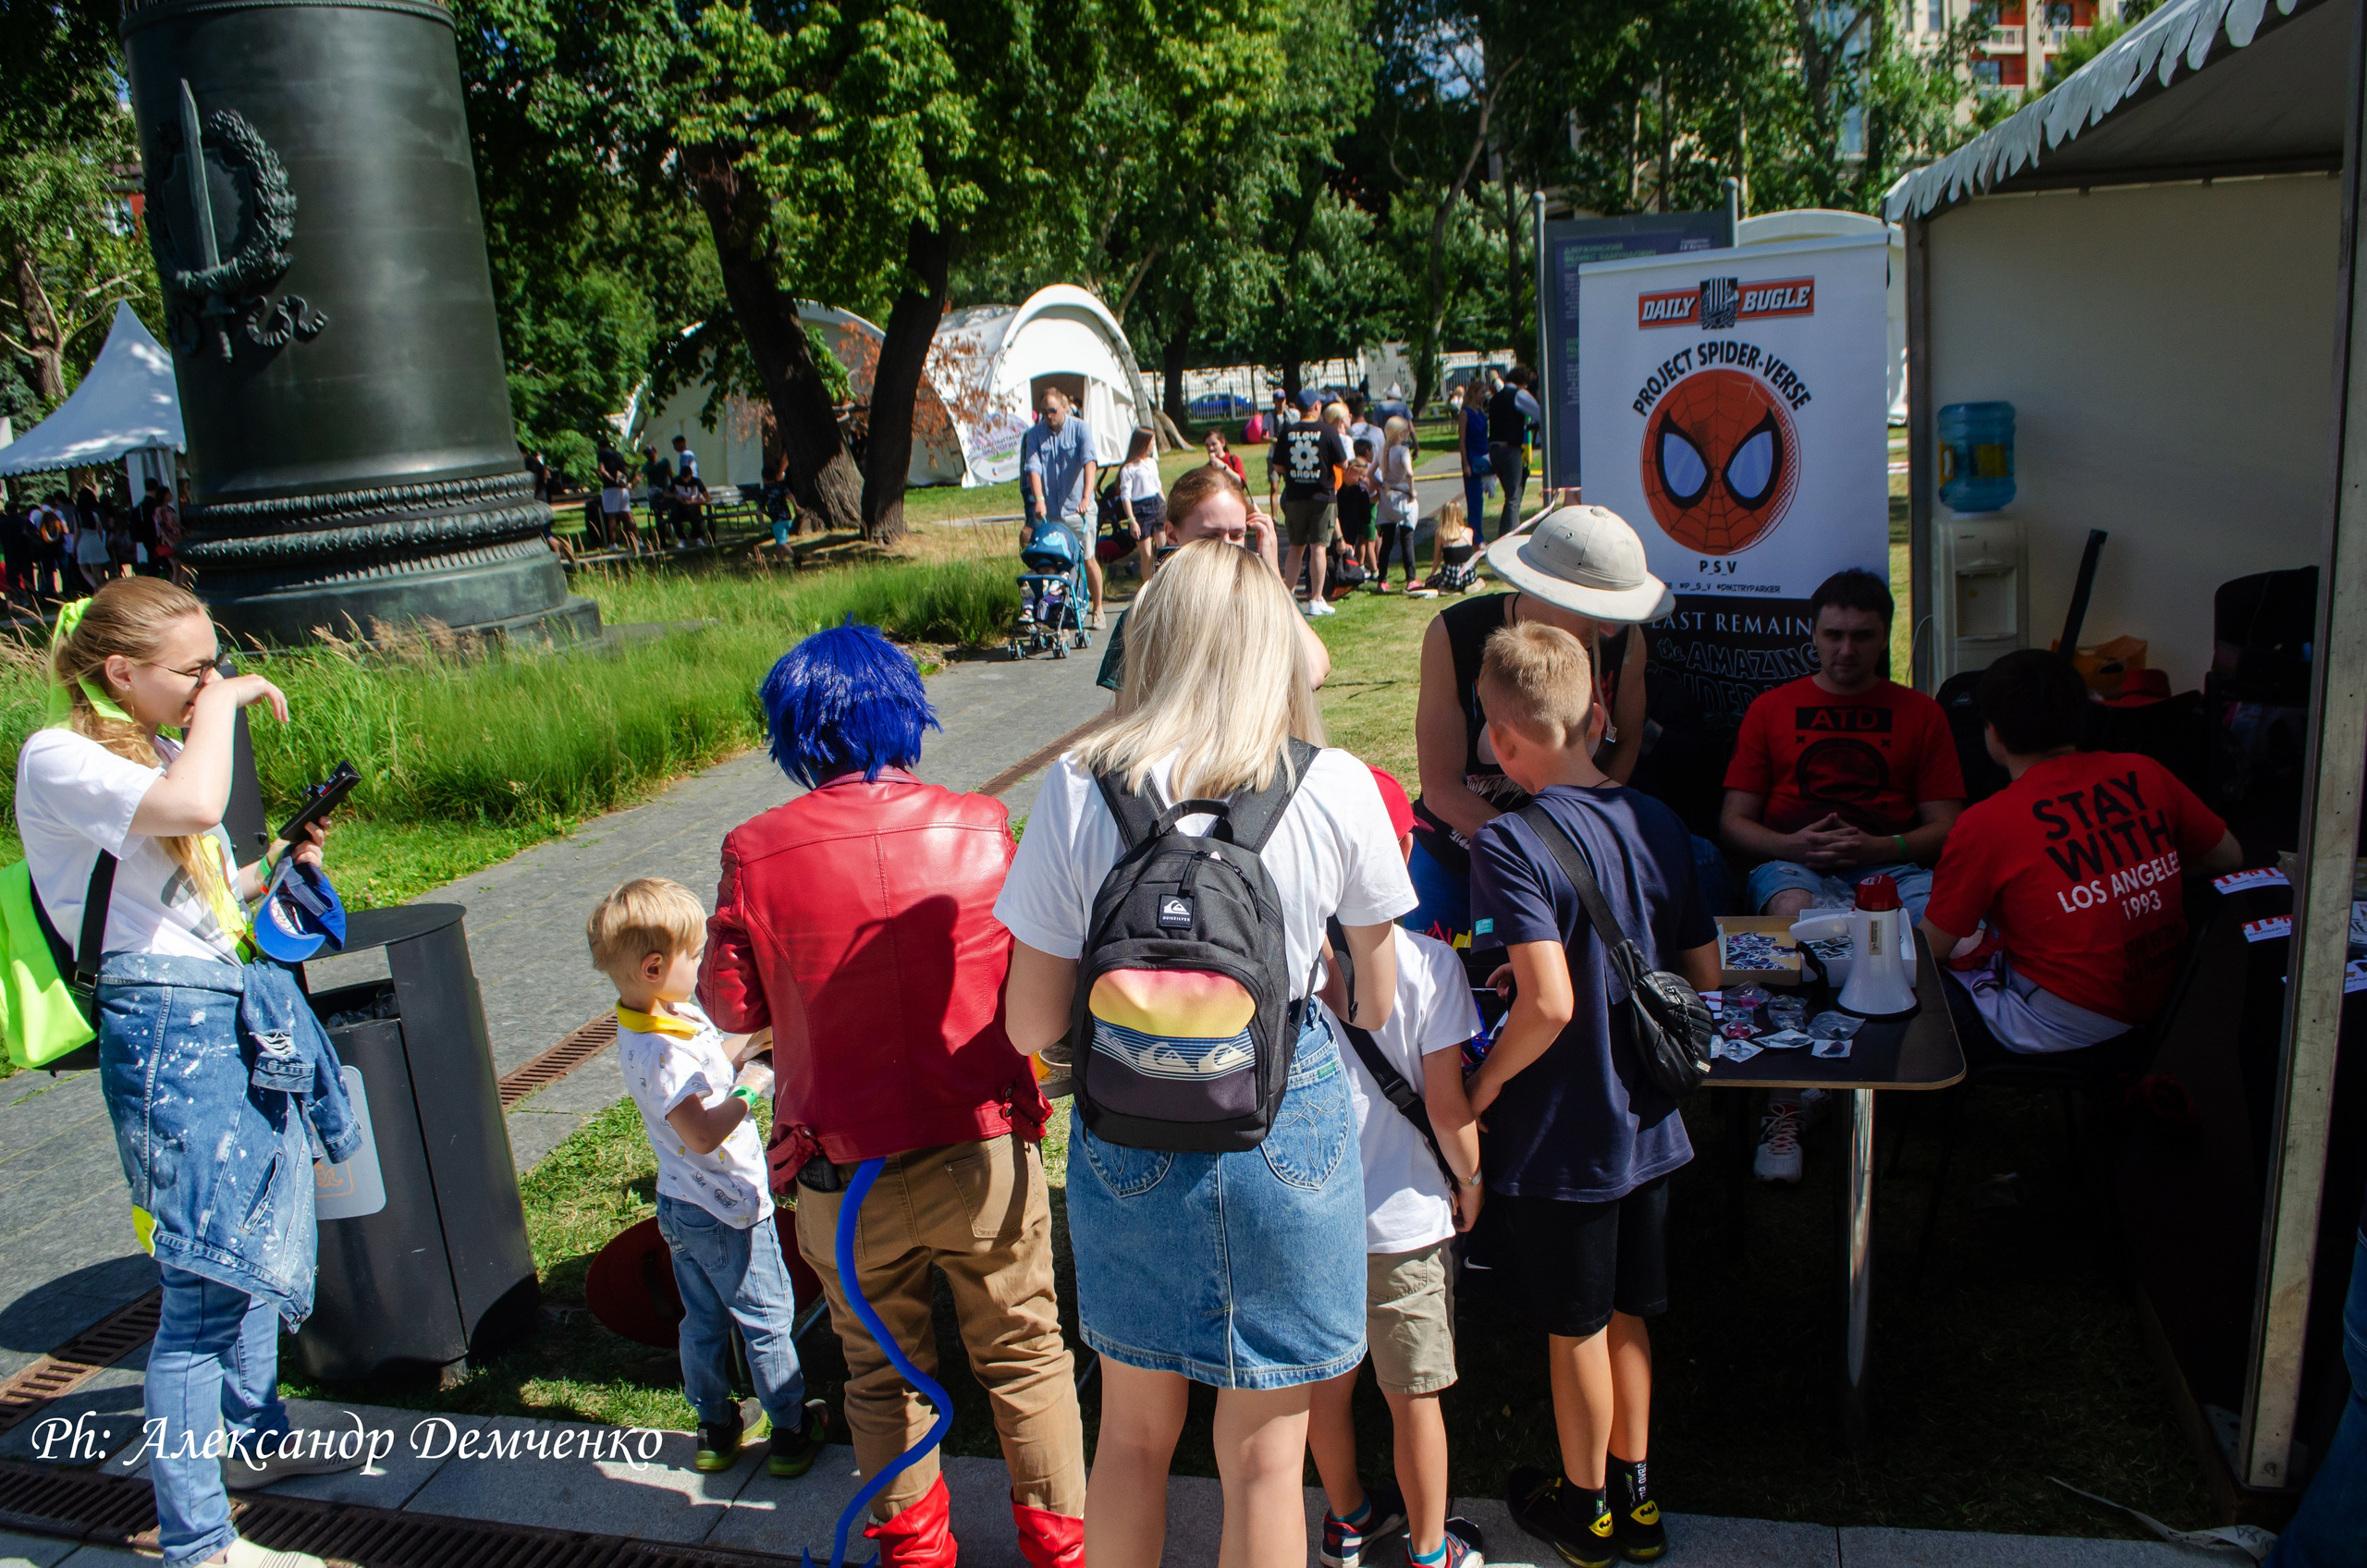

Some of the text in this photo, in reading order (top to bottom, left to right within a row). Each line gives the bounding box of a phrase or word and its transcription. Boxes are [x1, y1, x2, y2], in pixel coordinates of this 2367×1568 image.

[1641, 285, 1812, 322] DAILY BUGLE
[1632, 347, 1694, 418] PROJECT
[1697, 339, 1812, 411] SPIDER-VERSE
[1288, 432, 1321, 442] SLOW
[1290, 469, 1321, 479] GROW
[1699, 559, 1737, 575] P_S_V
[1686, 642, 1821, 680] AMAZING
[1809, 708, 1879, 729] ATD
[2032, 770, 2147, 840] STAY
[2045, 809, 2174, 883] WITH
[2056, 879, 2108, 914] LOS
[2121, 889, 2163, 921] 1993
